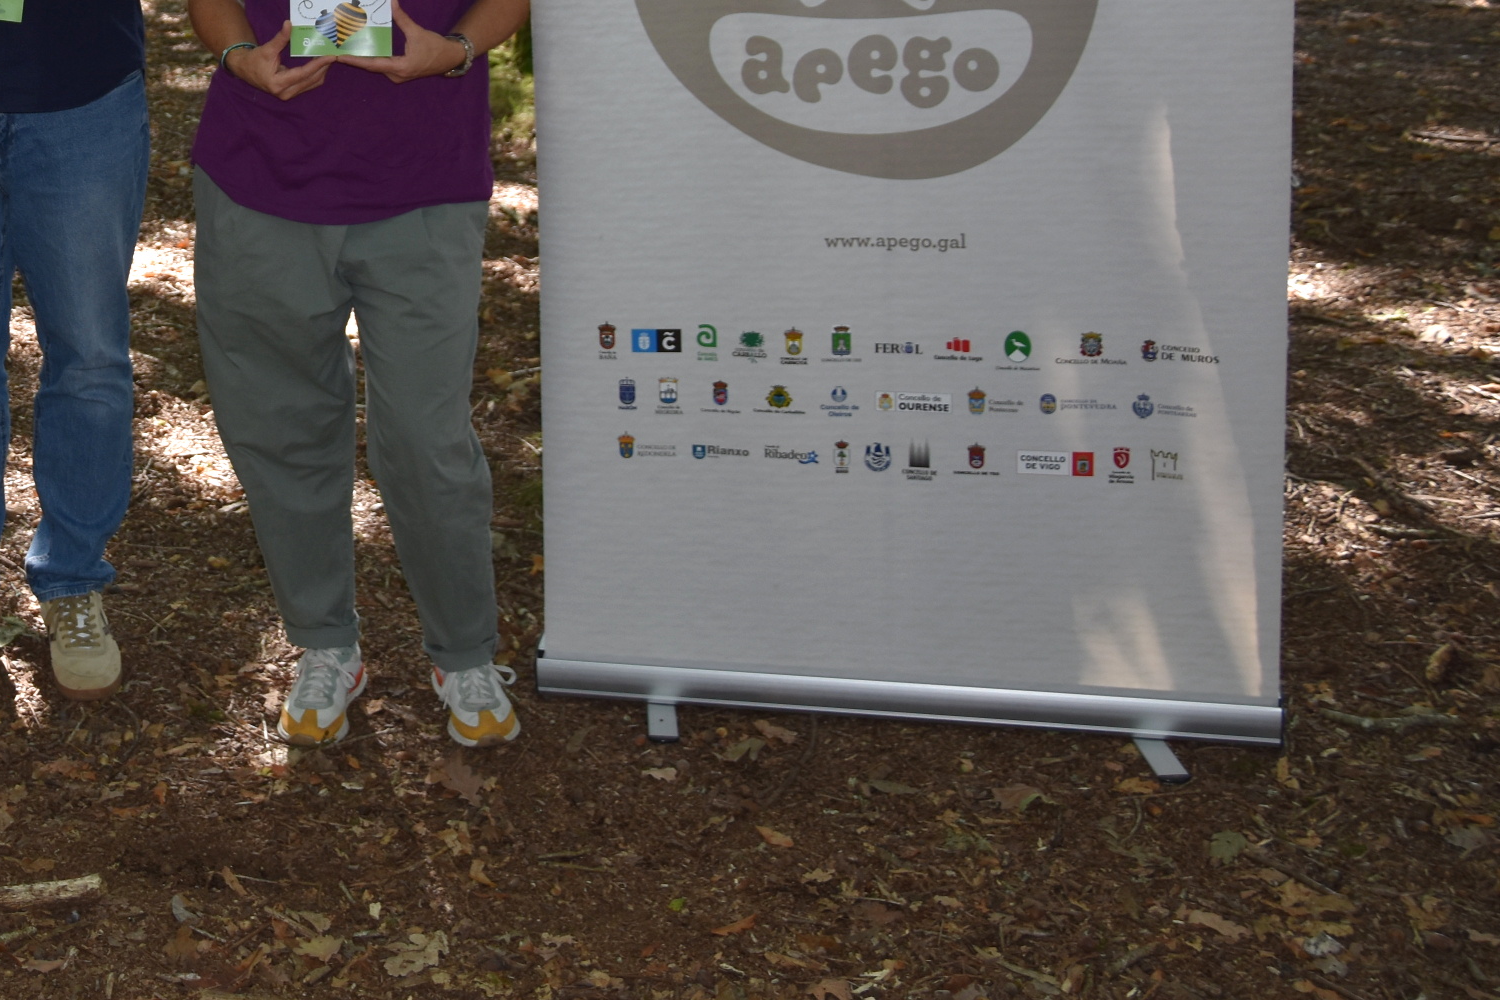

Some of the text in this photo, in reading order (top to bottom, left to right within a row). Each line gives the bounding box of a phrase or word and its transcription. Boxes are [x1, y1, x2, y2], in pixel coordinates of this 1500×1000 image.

[740, 33, 1000, 109] apego
[824, 233, 967, 253] www.apego.gal
[1161, 352, 1220, 364] DE MUROS
[898, 402, 950, 412] OURENSE
[707, 444, 750, 457] Rianxo
[764, 448, 808, 461] Ribadeo
[1020, 454, 1067, 463] CONCELLO
[1025, 462, 1061, 471] DE VIGO
